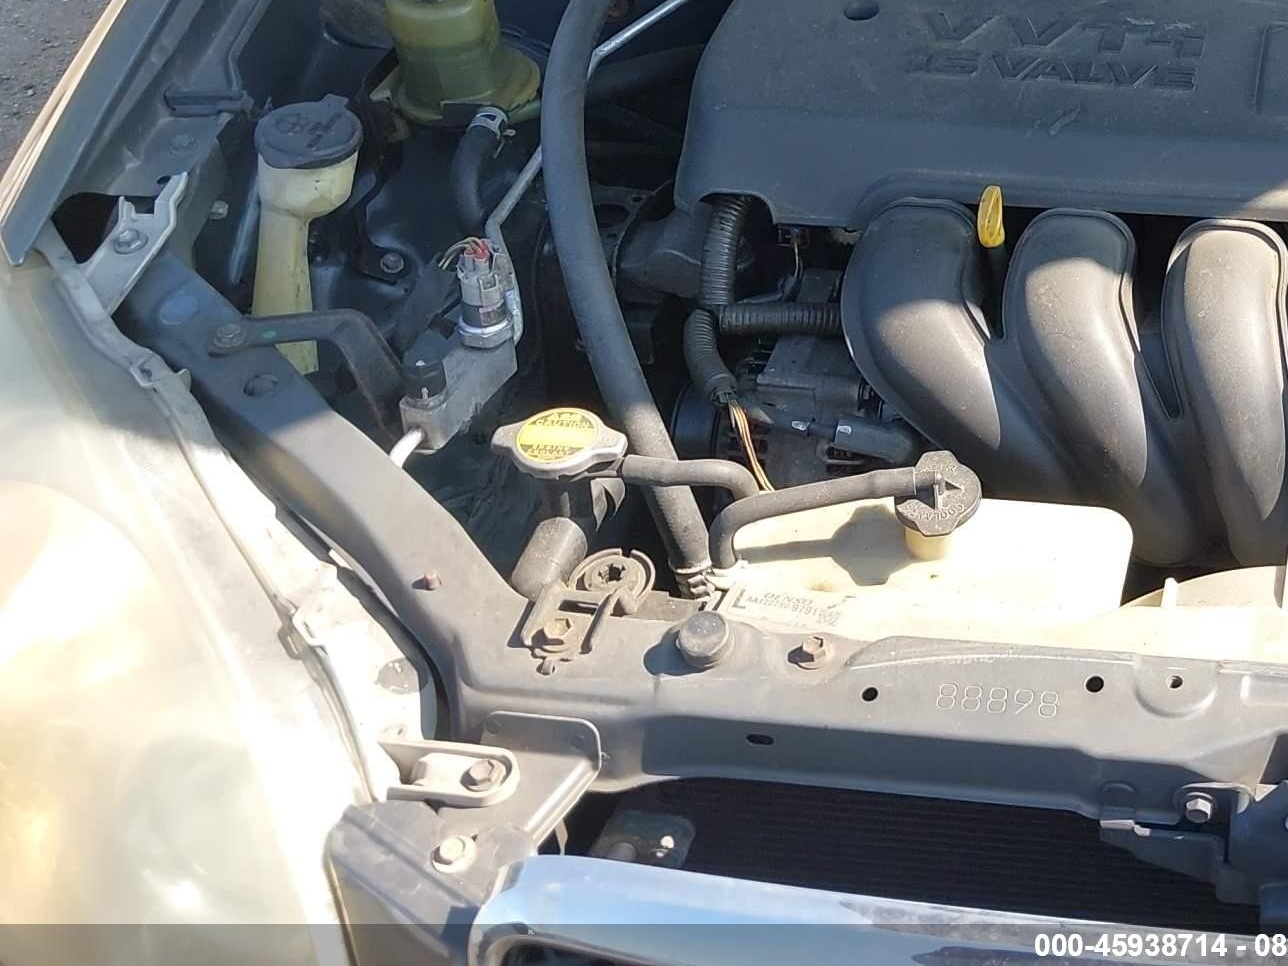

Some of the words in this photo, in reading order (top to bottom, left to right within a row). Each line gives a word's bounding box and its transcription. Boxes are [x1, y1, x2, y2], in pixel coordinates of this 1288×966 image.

[992, 53, 1199, 91] VALVE
[535, 418, 590, 429] CAUTION
[936, 682, 1060, 718] 88898
